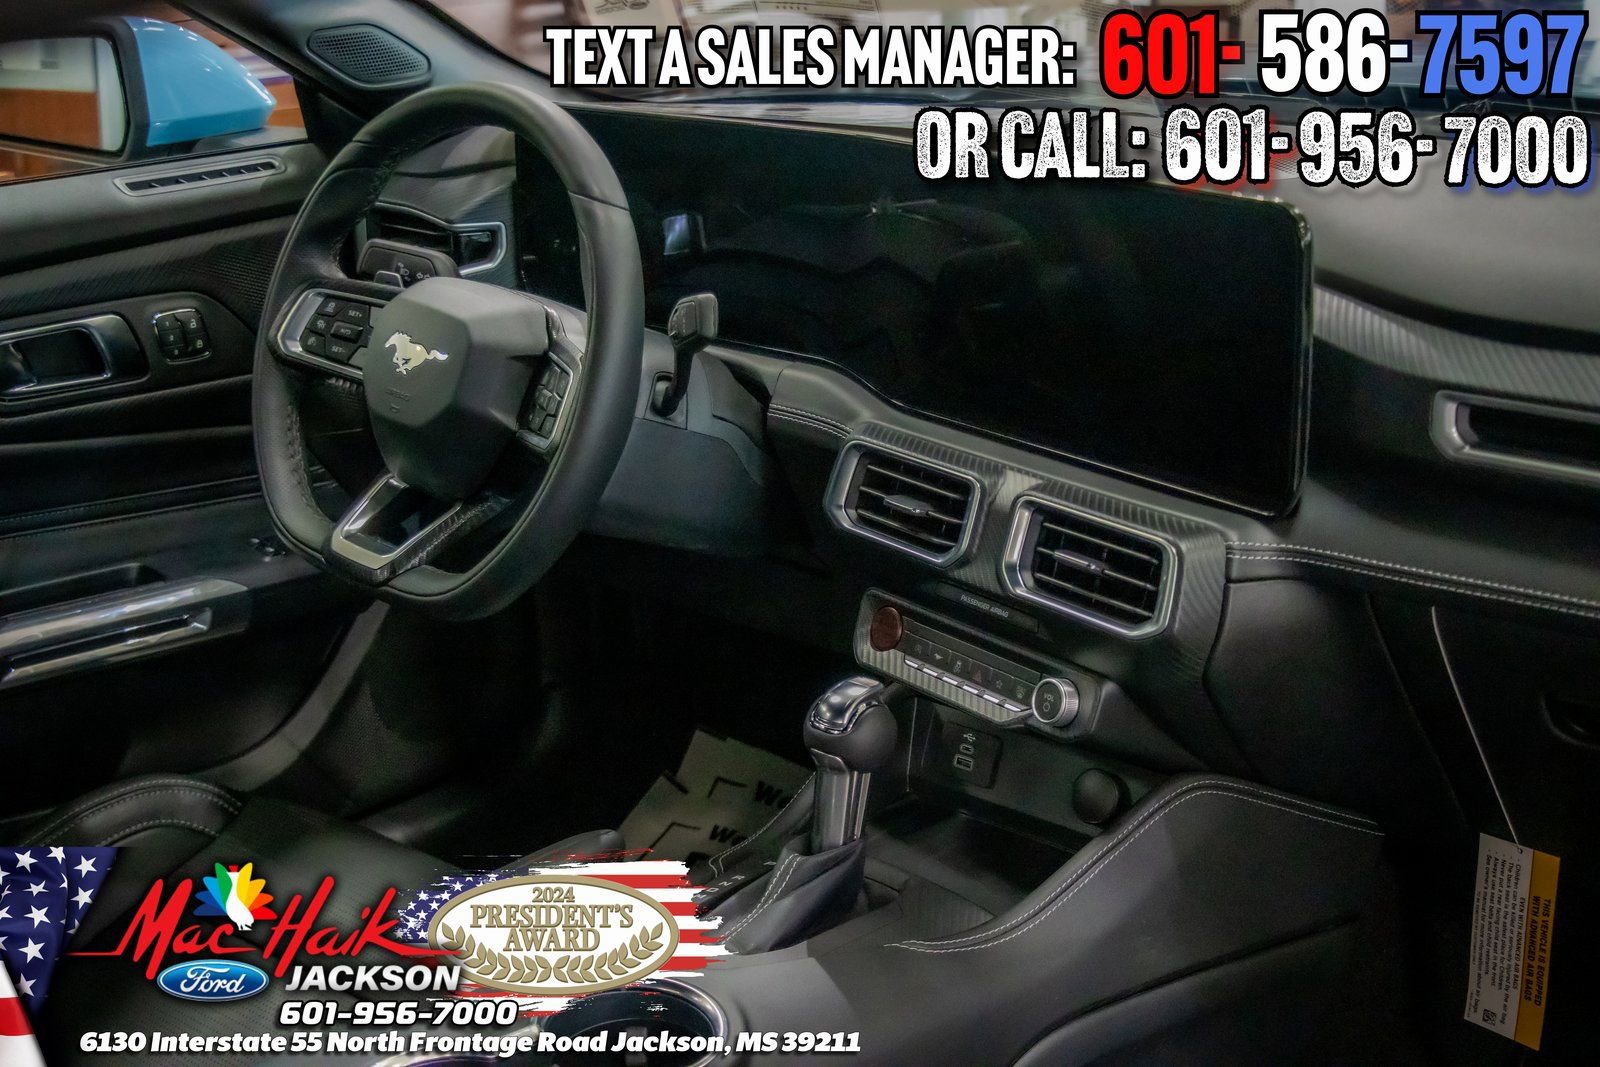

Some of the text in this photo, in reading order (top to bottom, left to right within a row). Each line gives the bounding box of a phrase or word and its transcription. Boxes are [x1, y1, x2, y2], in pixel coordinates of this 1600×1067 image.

[960, 594, 1009, 618] PASSENGER AIRBAG
[1531, 894, 1540, 917] WITH
[1542, 897, 1551, 918] THIS
[1527, 918, 1538, 962] ADVANCED
[1538, 918, 1548, 953] VEHICLE
[1522, 977, 1532, 1001] BAGS
[1532, 964, 1543, 1006] EQUIPPED
